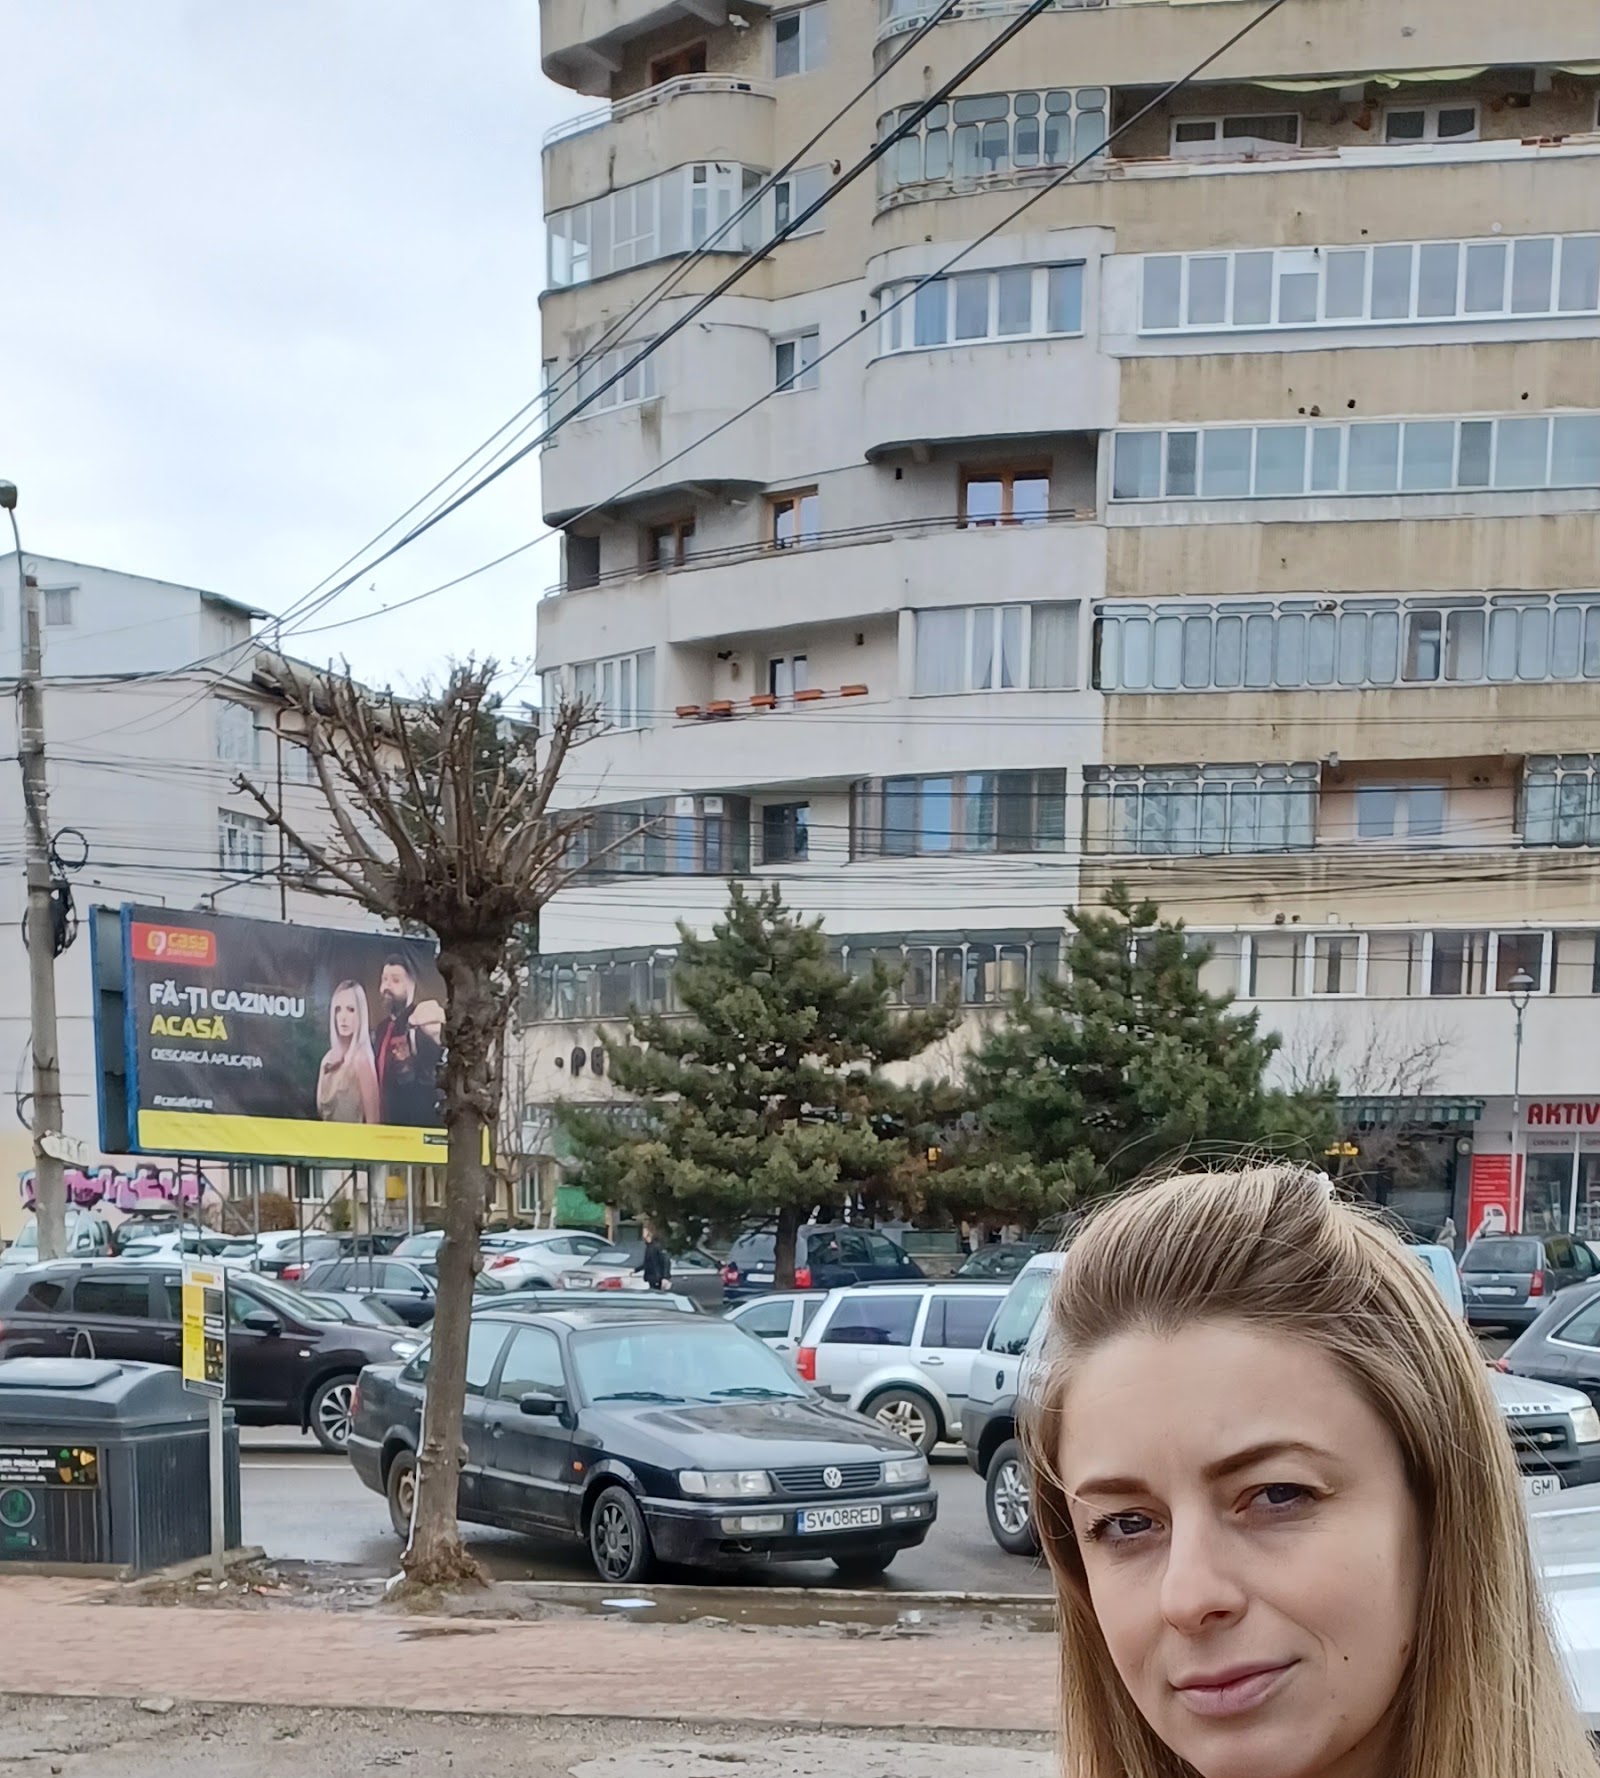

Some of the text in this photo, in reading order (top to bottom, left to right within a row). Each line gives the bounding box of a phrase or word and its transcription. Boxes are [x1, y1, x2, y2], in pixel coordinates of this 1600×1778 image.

[210, 989, 305, 1018] CAZINOU
[150, 1014, 228, 1041] ACASĂ
[1527, 1102, 1600, 1125] AKTIV
